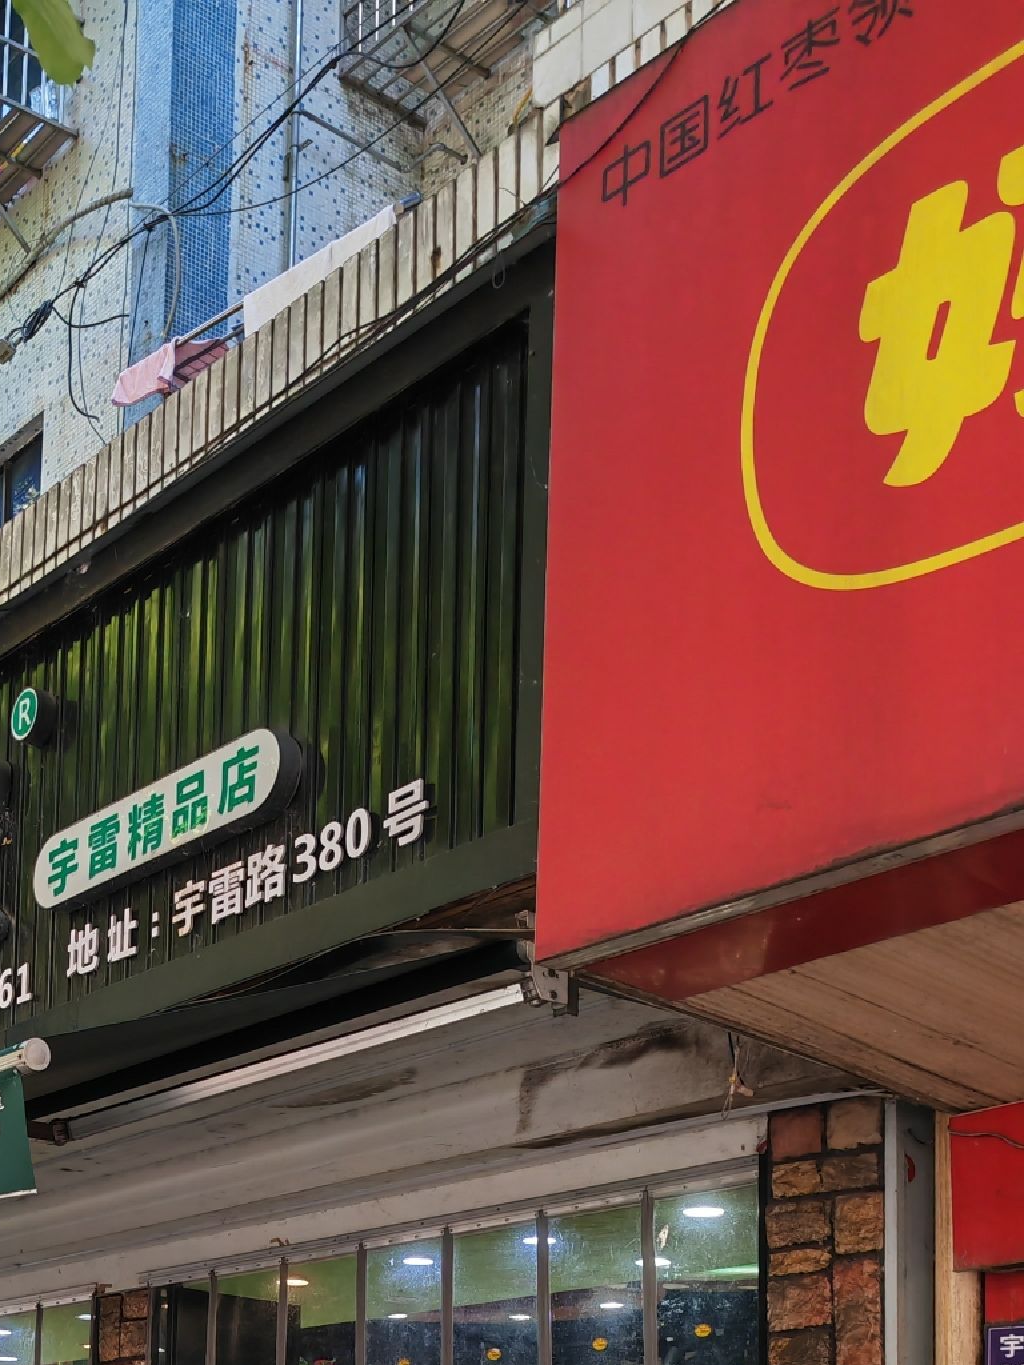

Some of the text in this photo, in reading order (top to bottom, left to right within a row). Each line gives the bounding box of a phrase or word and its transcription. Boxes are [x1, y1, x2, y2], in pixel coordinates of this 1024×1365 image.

[47, 741, 261, 898] 宇雷精品店
